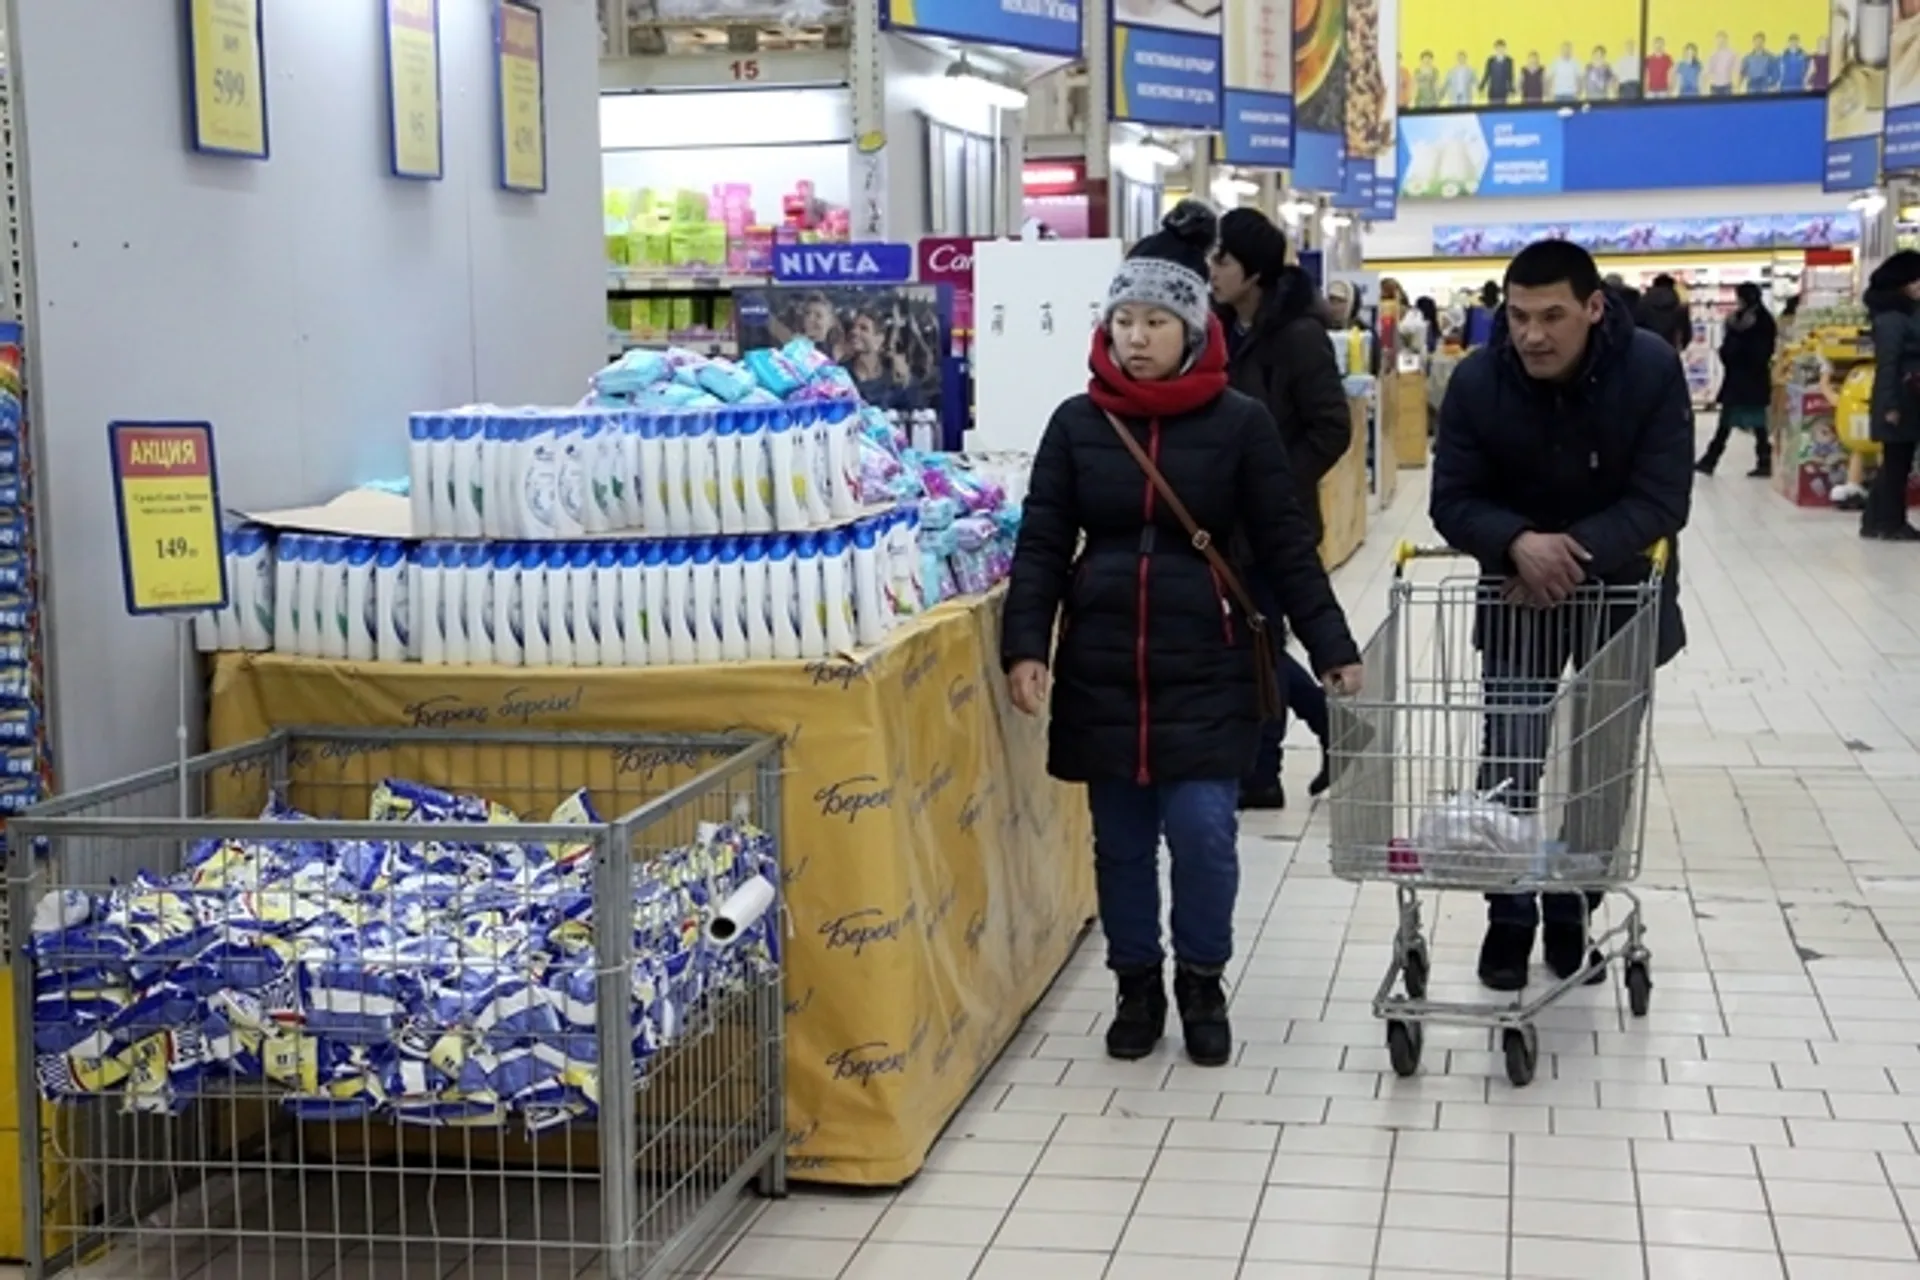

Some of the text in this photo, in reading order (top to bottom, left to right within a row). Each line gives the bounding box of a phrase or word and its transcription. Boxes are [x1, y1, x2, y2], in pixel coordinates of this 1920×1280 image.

[729, 60, 759, 80] 15
[780, 251, 880, 275] NIVEA
[130, 438, 197, 469] АКЦИЯ
[155, 536, 188, 560] 149
